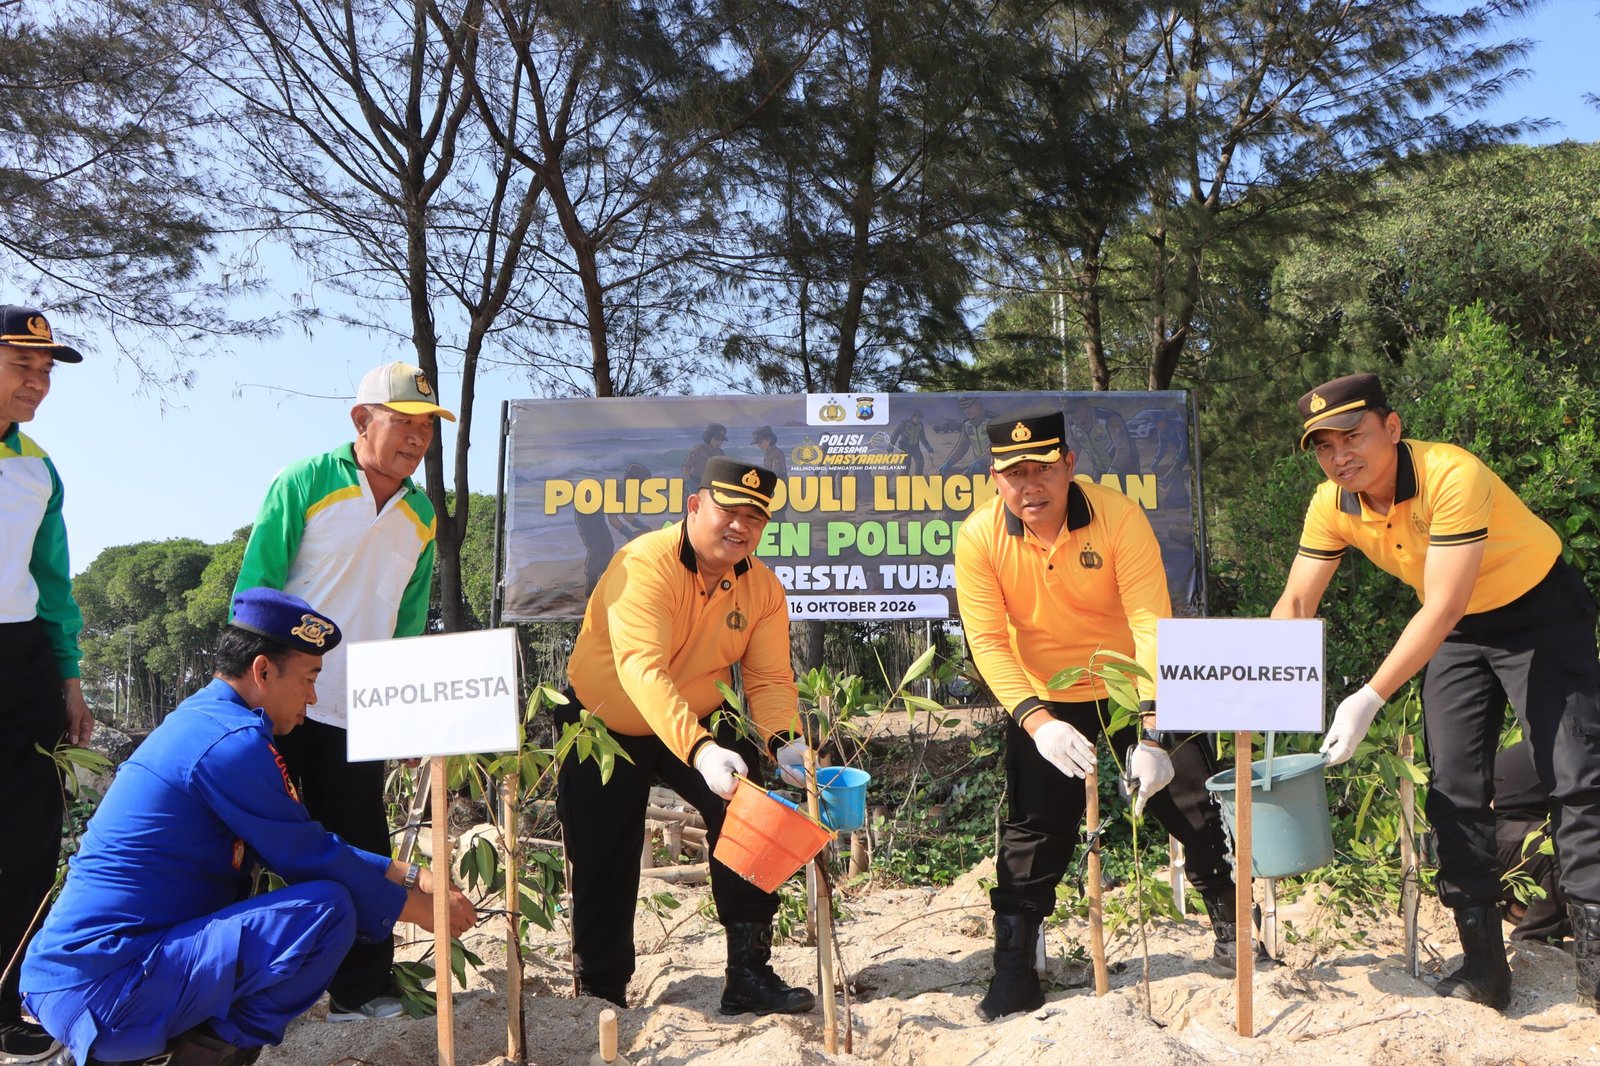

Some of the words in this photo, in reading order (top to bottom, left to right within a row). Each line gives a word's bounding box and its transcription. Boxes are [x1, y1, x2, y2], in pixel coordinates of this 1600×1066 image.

[819, 434, 864, 446] POLISI
[827, 446, 868, 454] BERSAMA
[822, 453, 908, 465] MASYARAKAT
[544, 478, 684, 515] POLISI
[790, 601, 803, 613] 16
[806, 601, 876, 613] OKTOBER
[880, 600, 916, 613] 2026
[1160, 664, 1319, 682] WAKAPOLRESTA
[352, 676, 509, 709] KAPOLRESTA
